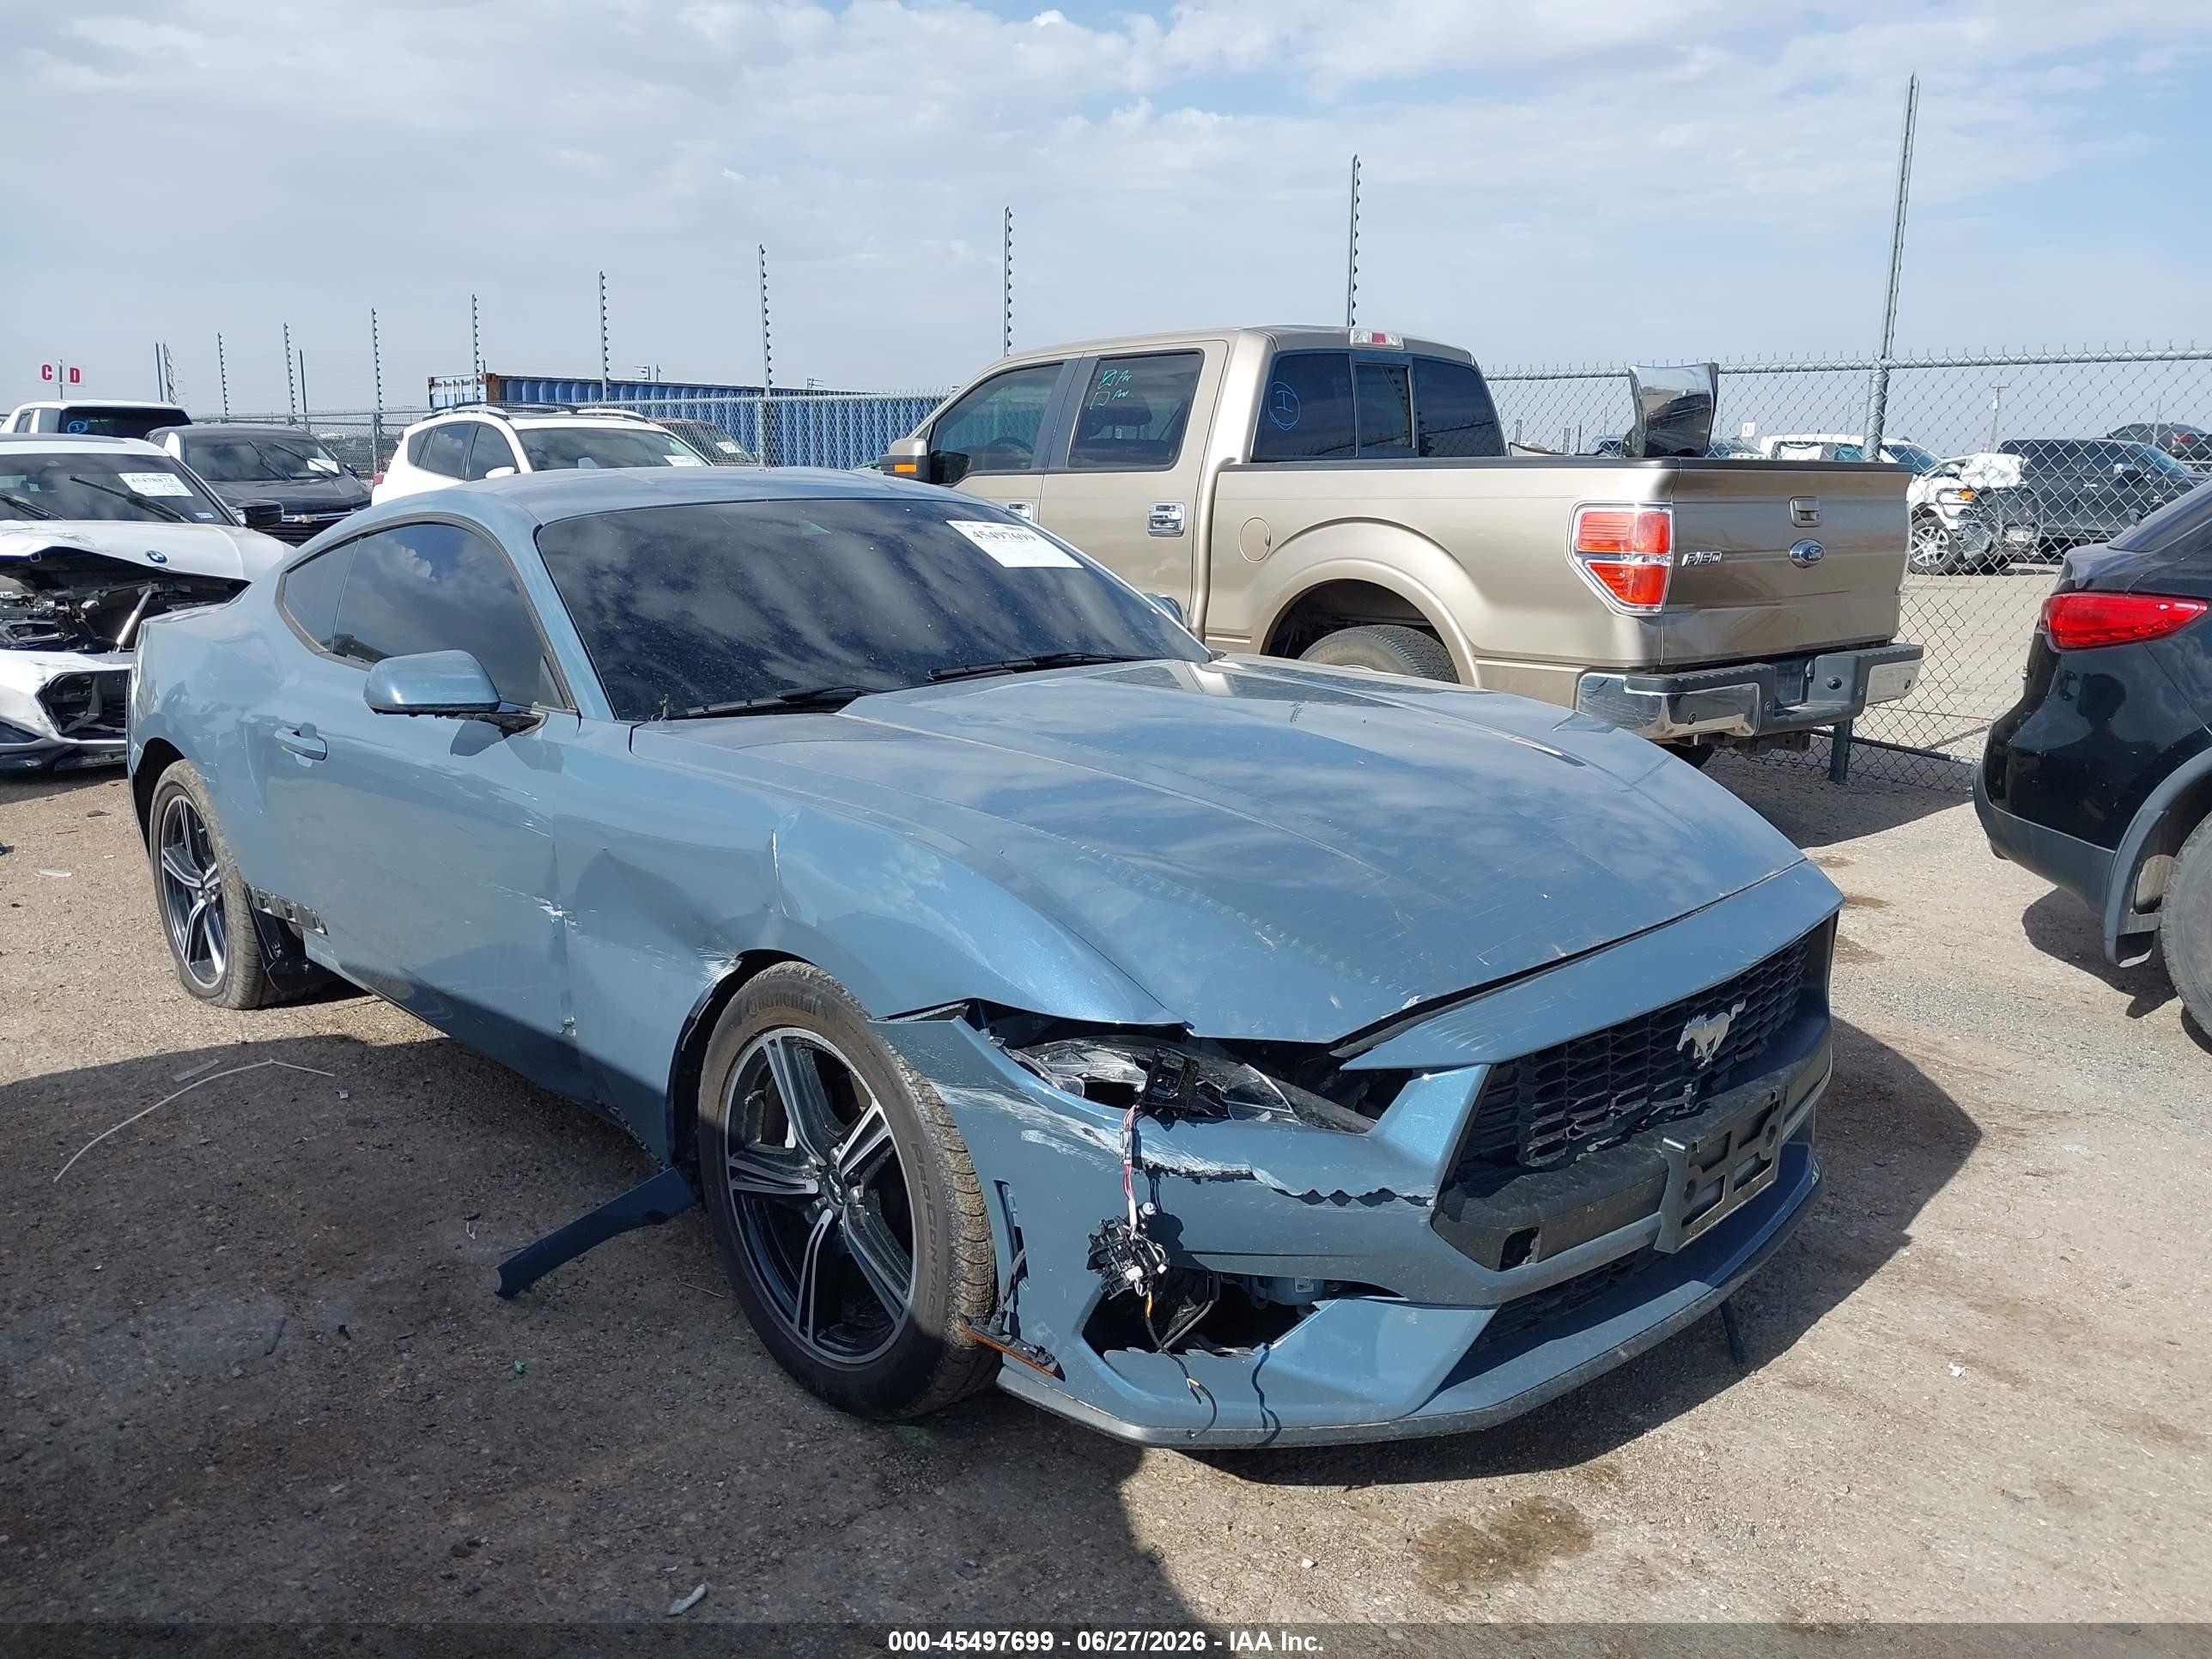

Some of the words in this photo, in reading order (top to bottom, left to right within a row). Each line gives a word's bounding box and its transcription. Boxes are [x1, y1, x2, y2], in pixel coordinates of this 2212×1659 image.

[41, 364, 52, 380] C
[70, 367, 81, 383] D
[1808, 547, 1823, 559] Ford
